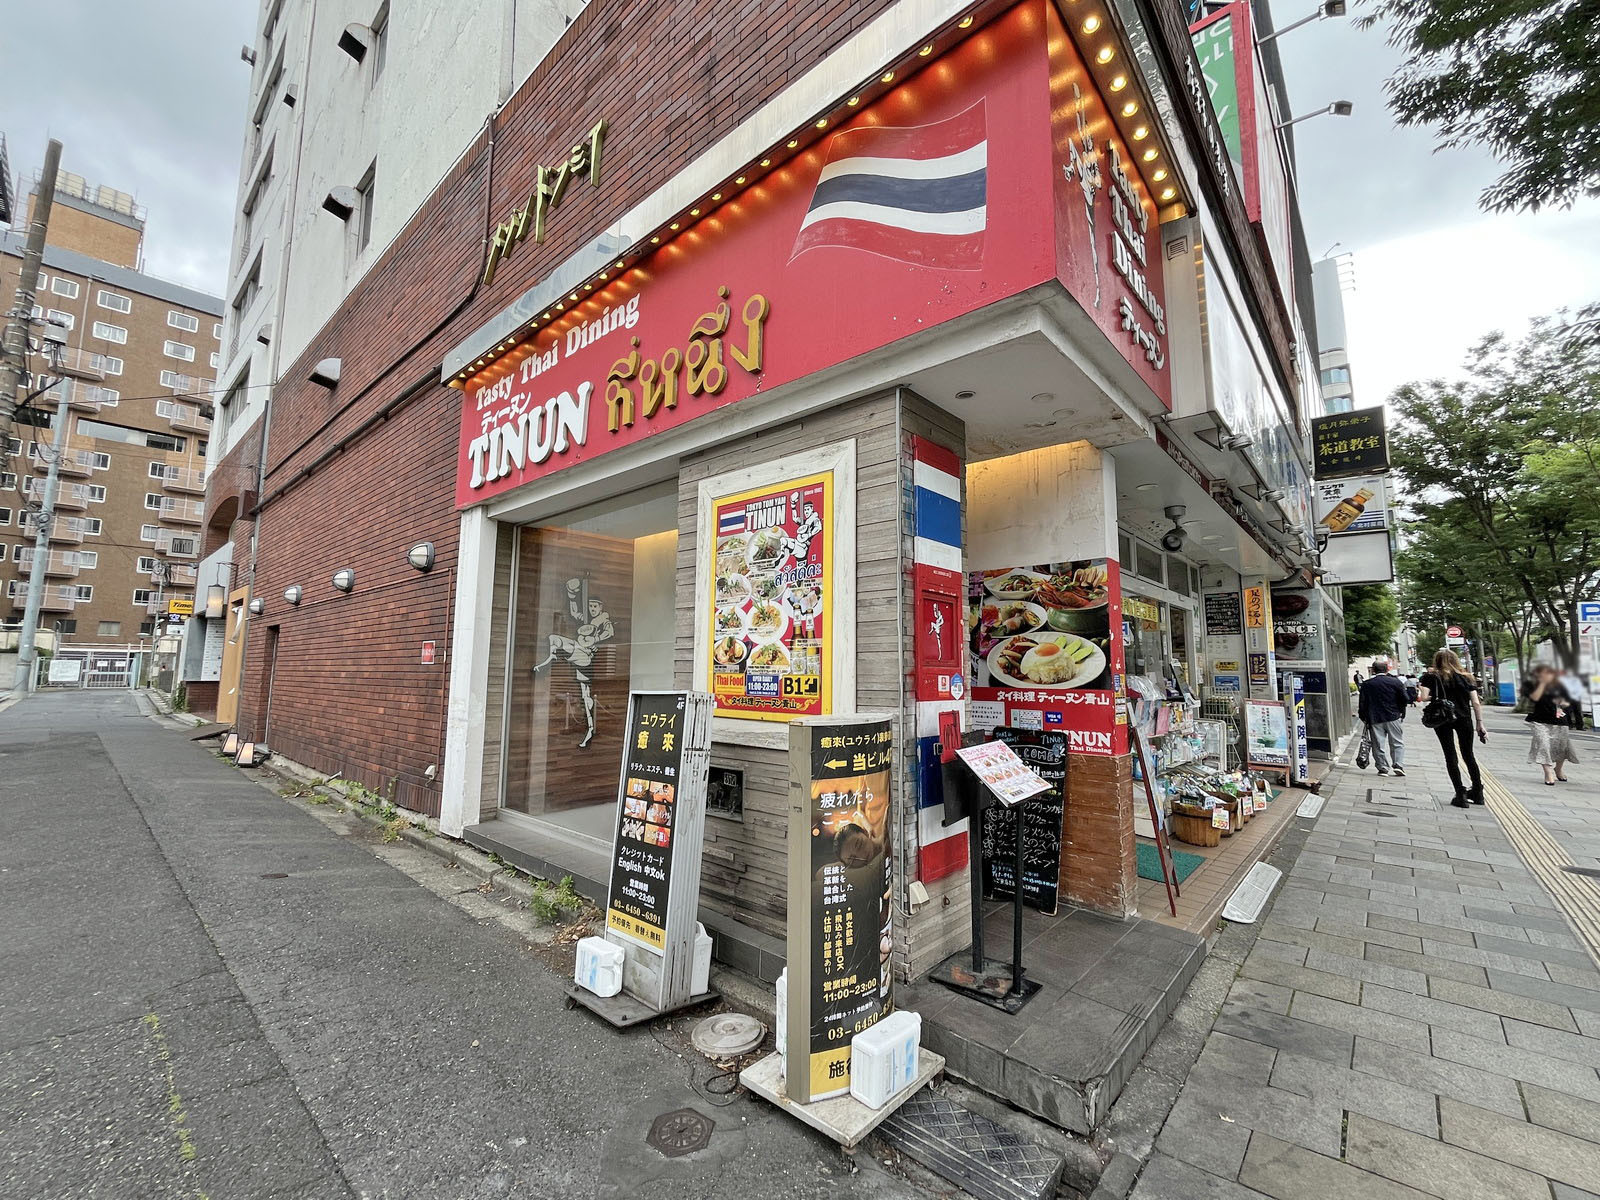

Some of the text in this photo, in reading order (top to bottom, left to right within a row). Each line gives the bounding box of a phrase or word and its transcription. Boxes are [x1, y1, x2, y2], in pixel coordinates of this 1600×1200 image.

[1108, 138, 1149, 234] Tasty
[1109, 185, 1147, 267] Thai
[1112, 231, 1166, 336] Dining
[1120, 296, 1165, 370] ティーヌン
[475, 293, 640, 411] Tasty Thai Dining
[480, 391, 531, 434] ティーヌン
[468, 381, 594, 489] TINUN
[1319, 436, 1380, 456] 茶道教室
[745, 504, 786, 531] TINUN
[746, 501, 763, 512] TOKYO
[1251, 589, 1262, 625] 足のつる人
[1259, 655, 1267, 673] トノス
[716, 675, 744, 687] Thai Food
[783, 677, 803, 695] B1
[676, 701, 685, 710] 4F
[731, 697, 797, 709] タイ料理 ティーヌン青山
[997, 690, 1110, 705] タイ料理 ティーヌン青山
[640, 712, 677, 729] ユウライ
[820, 787, 874, 809] 疲れたら
[822, 810, 864, 826] ここへ
[621, 845, 665, 867] クレジットカード
[618, 857, 666, 881] English 中文ok
[823, 865, 846, 876] 伝統と
[823, 874, 847, 885] 革新を
[629, 878, 649, 892] 営業時間
[823, 883, 854, 896] 融合した
[823, 893, 847, 905] 台湾式
[611, 915, 661, 943] 予約優先 着替え無料
[845, 911, 854, 946] 男女歓迎
[823, 916, 832, 976] 仕切り部屋あり
[835, 914, 845, 972] 飛込み来店OK
[823, 974, 857, 992] 営業時間
[855, 1011, 879, 1033] 6450
